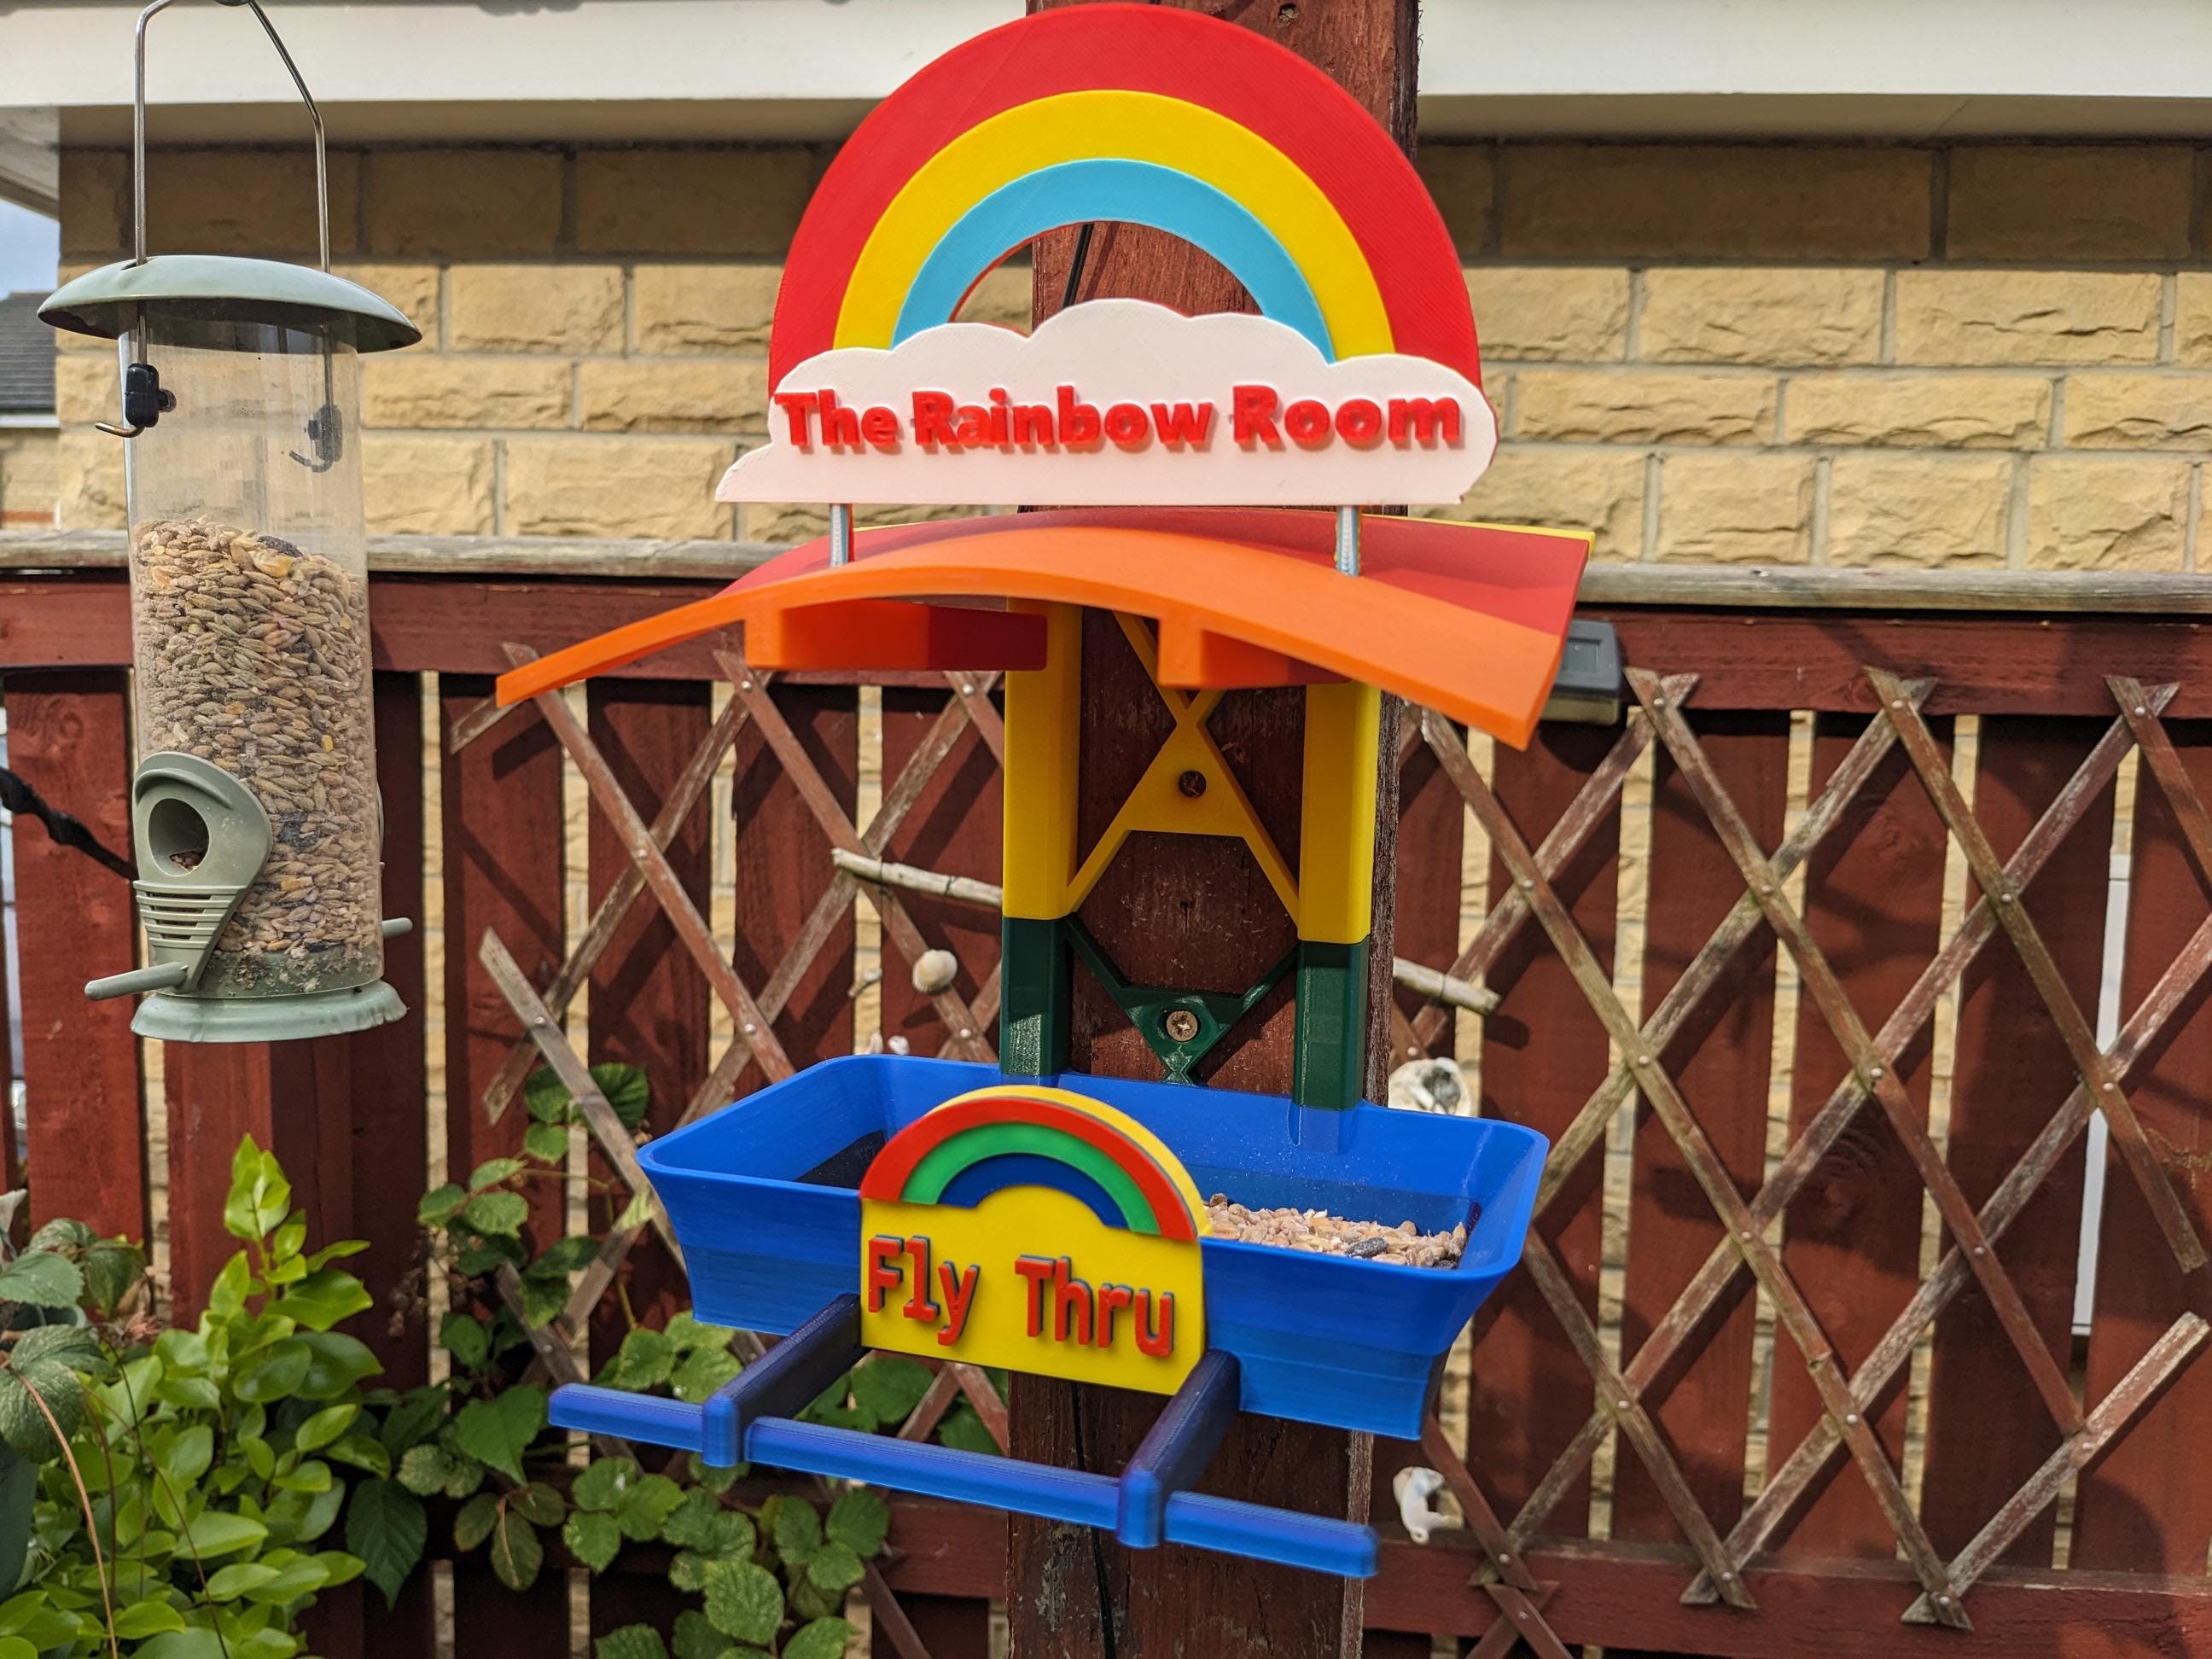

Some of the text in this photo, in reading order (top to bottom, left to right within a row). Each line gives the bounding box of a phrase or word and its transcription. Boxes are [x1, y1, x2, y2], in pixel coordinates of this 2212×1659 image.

[775, 383, 1463, 449] The Rainbow Room
[868, 1235, 1175, 1358] Fly Thru
